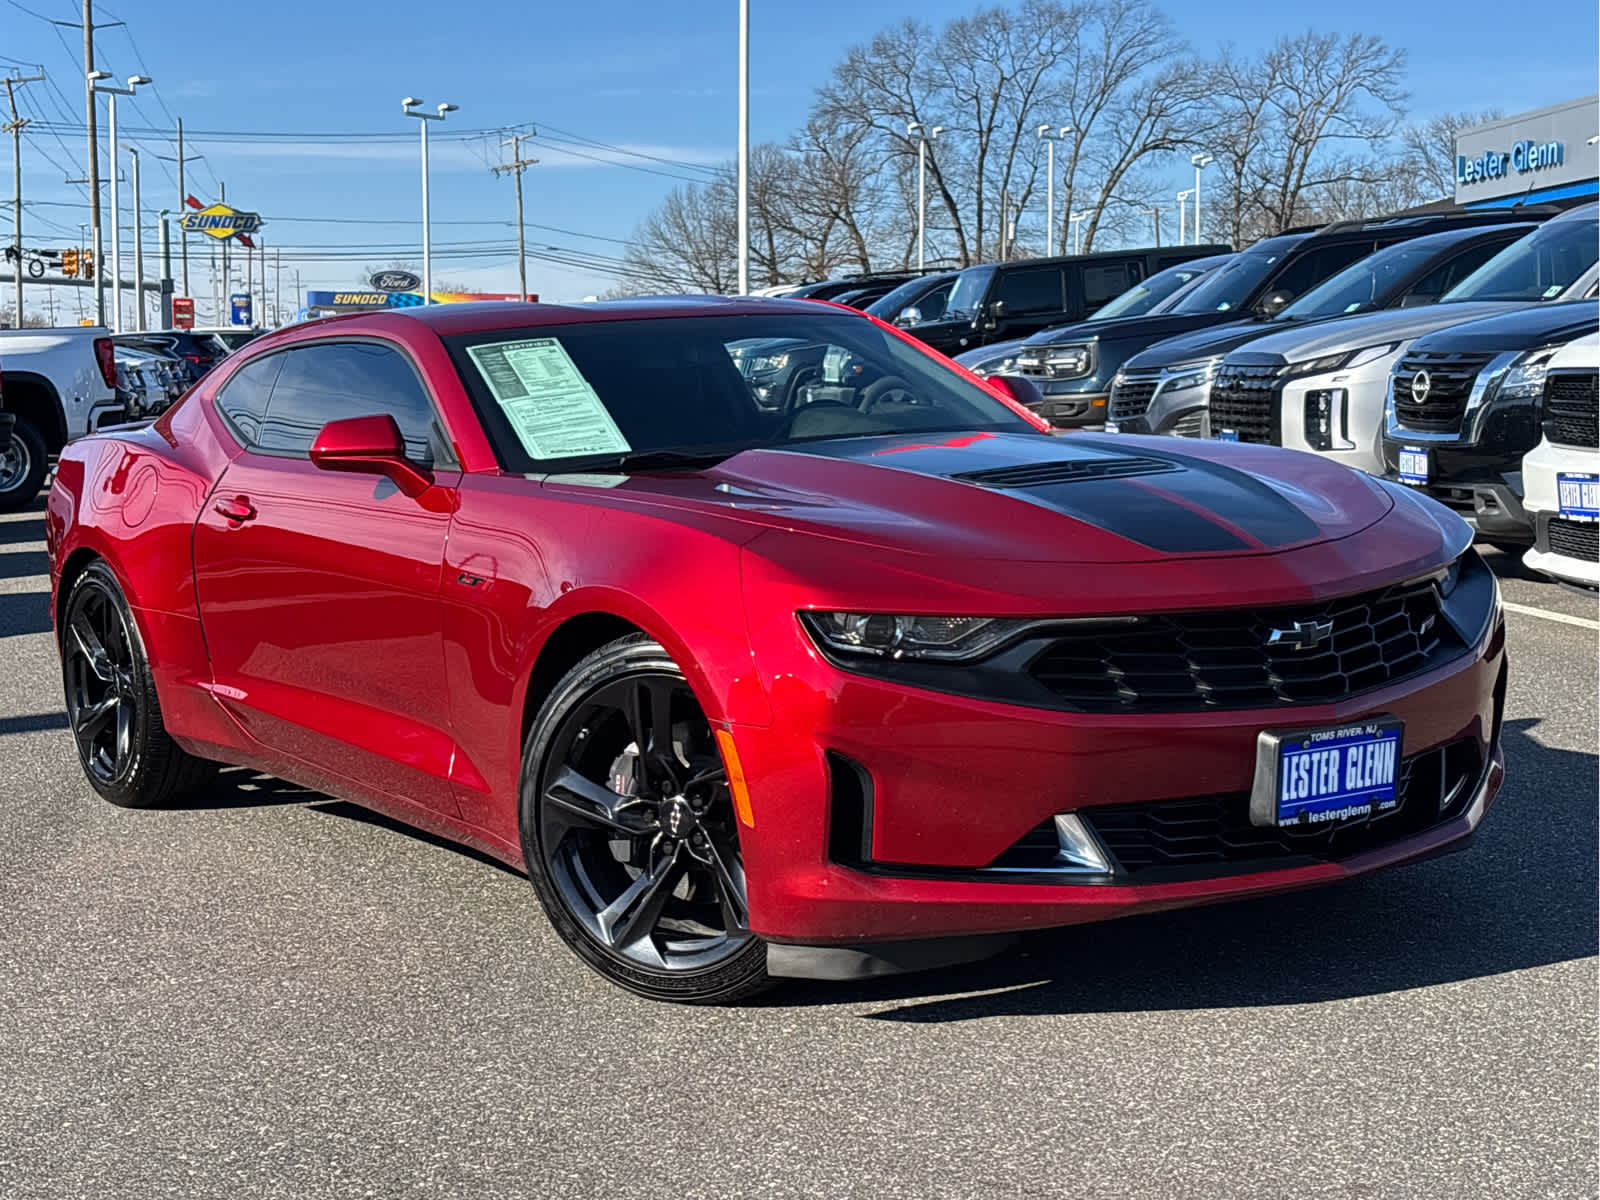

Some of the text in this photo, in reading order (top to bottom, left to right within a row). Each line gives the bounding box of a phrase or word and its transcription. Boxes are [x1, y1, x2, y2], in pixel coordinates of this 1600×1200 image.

[1456, 140, 1564, 183] Lester Glenn
[184, 215, 258, 230] SUNOCO
[380, 274, 411, 288] Ford
[333, 293, 388, 305] SUNOCO
[502, 341, 550, 351] CERTIFIED
[457, 572, 486, 588] LT
[1310, 731, 1335, 742] TOMS
[1365, 724, 1378, 735] NJ
[1281, 740, 1397, 802] LESTER GLENN
